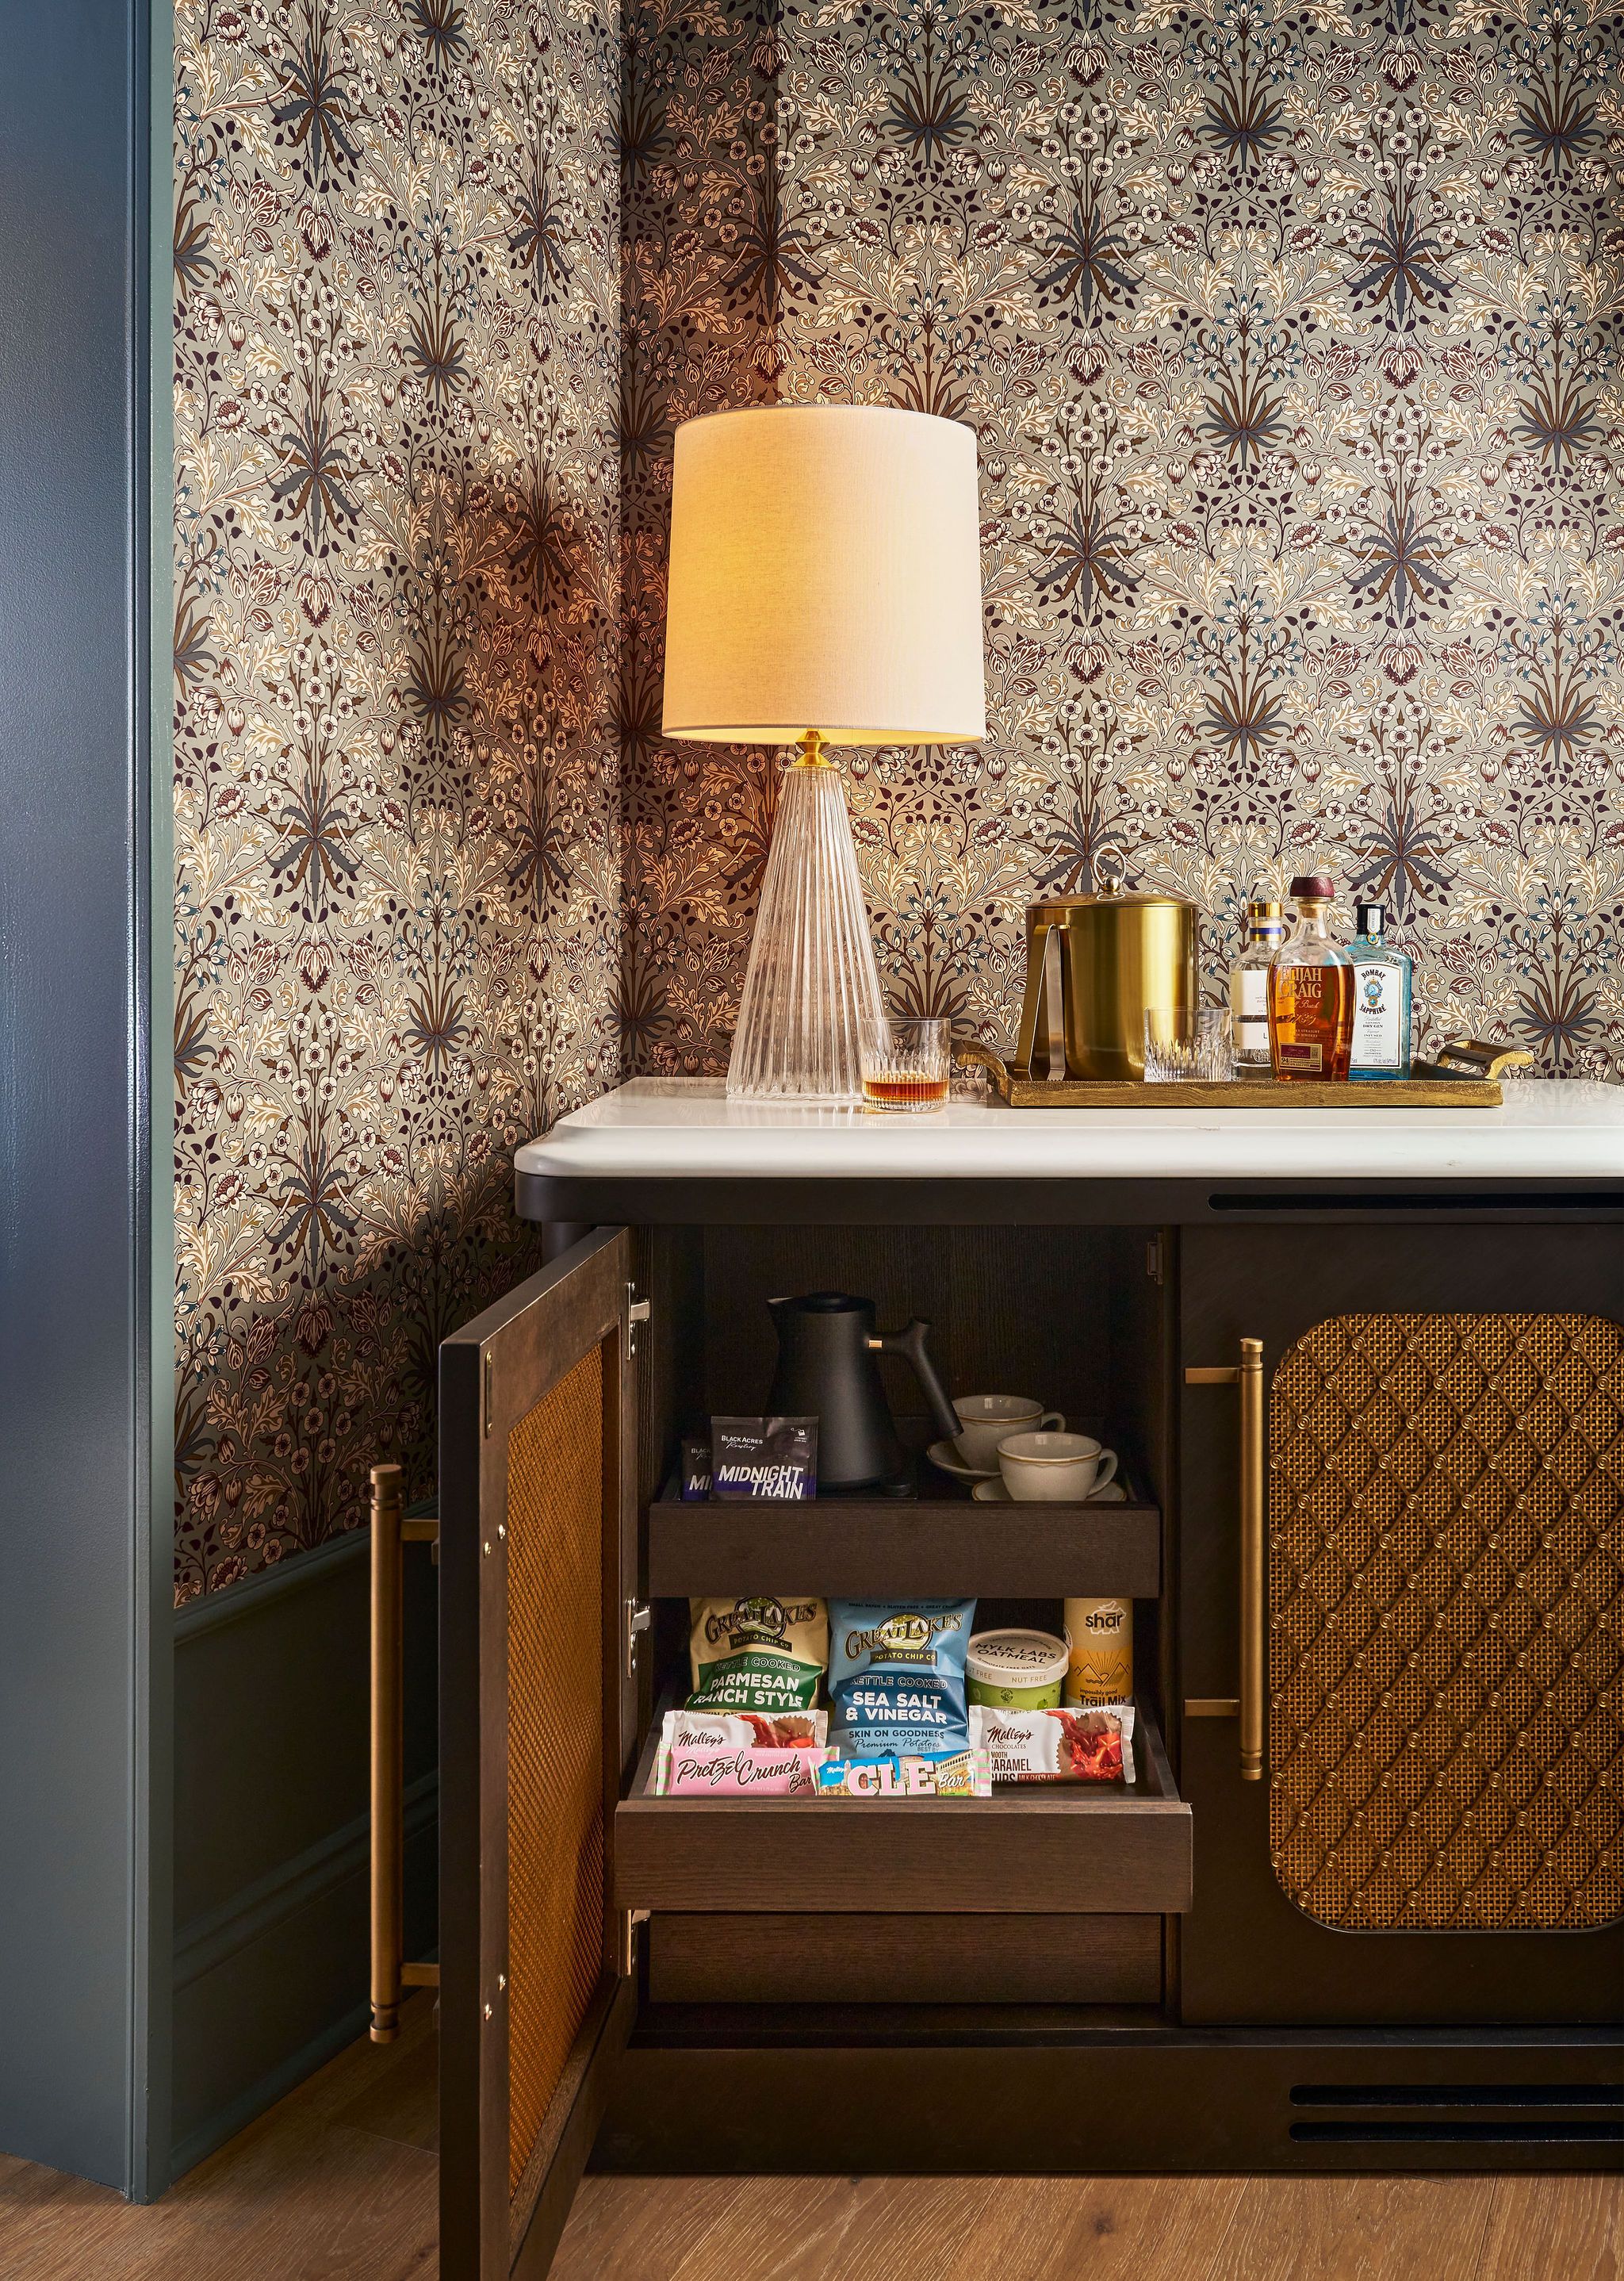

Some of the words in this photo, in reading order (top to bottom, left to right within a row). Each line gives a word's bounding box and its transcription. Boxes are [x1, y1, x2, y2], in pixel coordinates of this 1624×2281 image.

[1280, 964, 1323, 983] ELIJAH
[1361, 969, 1387, 981] BOMBAY
[1280, 980, 1323, 999] CRAIG
[1359, 1004, 1387, 1015] SAPPHIRE
[718, 1465, 804, 1485] MIDNIGHT
[752, 1480, 804, 1500] TRAIN
[705, 1610, 761, 1645] GREAT
[759, 1602, 818, 1627] LAKES
[733, 1634, 759, 1644] POTATO
[761, 1635, 779, 1644] CHIP
[845, 1626, 906, 1661] GREAT
[902, 1613, 963, 1641] LAKES
[875, 1652, 903, 1662] POTATO
[975, 1643, 1016, 1653] MYLK
[1019, 1649, 1057, 1659] LABS
[977, 1650, 1046, 1664] OATMEAL
[715, 1657, 748, 1672] KETTLE
[751, 1657, 801, 1672] COOKED
[710, 1673, 800, 1692] PARMESAN
[850, 1675, 894, 1686] KETTLE
[898, 1677, 948, 1689] COOKED
[976, 1670, 993, 1680] FREE
[693, 1689, 748, 1704] RANCH
[754, 1690, 803, 1708] STYLE
[1079, 1688, 1105, 1696] impossibly
[852, 1692, 890, 1707] SEA
[896, 1693, 942, 1709] SALT
[1107, 1695, 1127, 1706] Mix
[845, 1707, 858, 1721] &
[865, 1708, 948, 1725] VINEGAR
[678, 1731, 726, 1746] Malley's
[848, 1730, 871, 1739] SKIN
[892, 1730, 944, 1739] GOODNESS
[986, 1726, 1034, 1744] Malley's
[854, 1739, 898, 1749] Premium
[902, 1738, 940, 1748] Potatoes
[676, 1750, 745, 1786] Pretzel
[737, 1754, 801, 1786] Crunch
[788, 1773, 813, 1793] Bar
[848, 1761, 936, 1796] CLE
[938, 1773, 965, 1788] Bar
